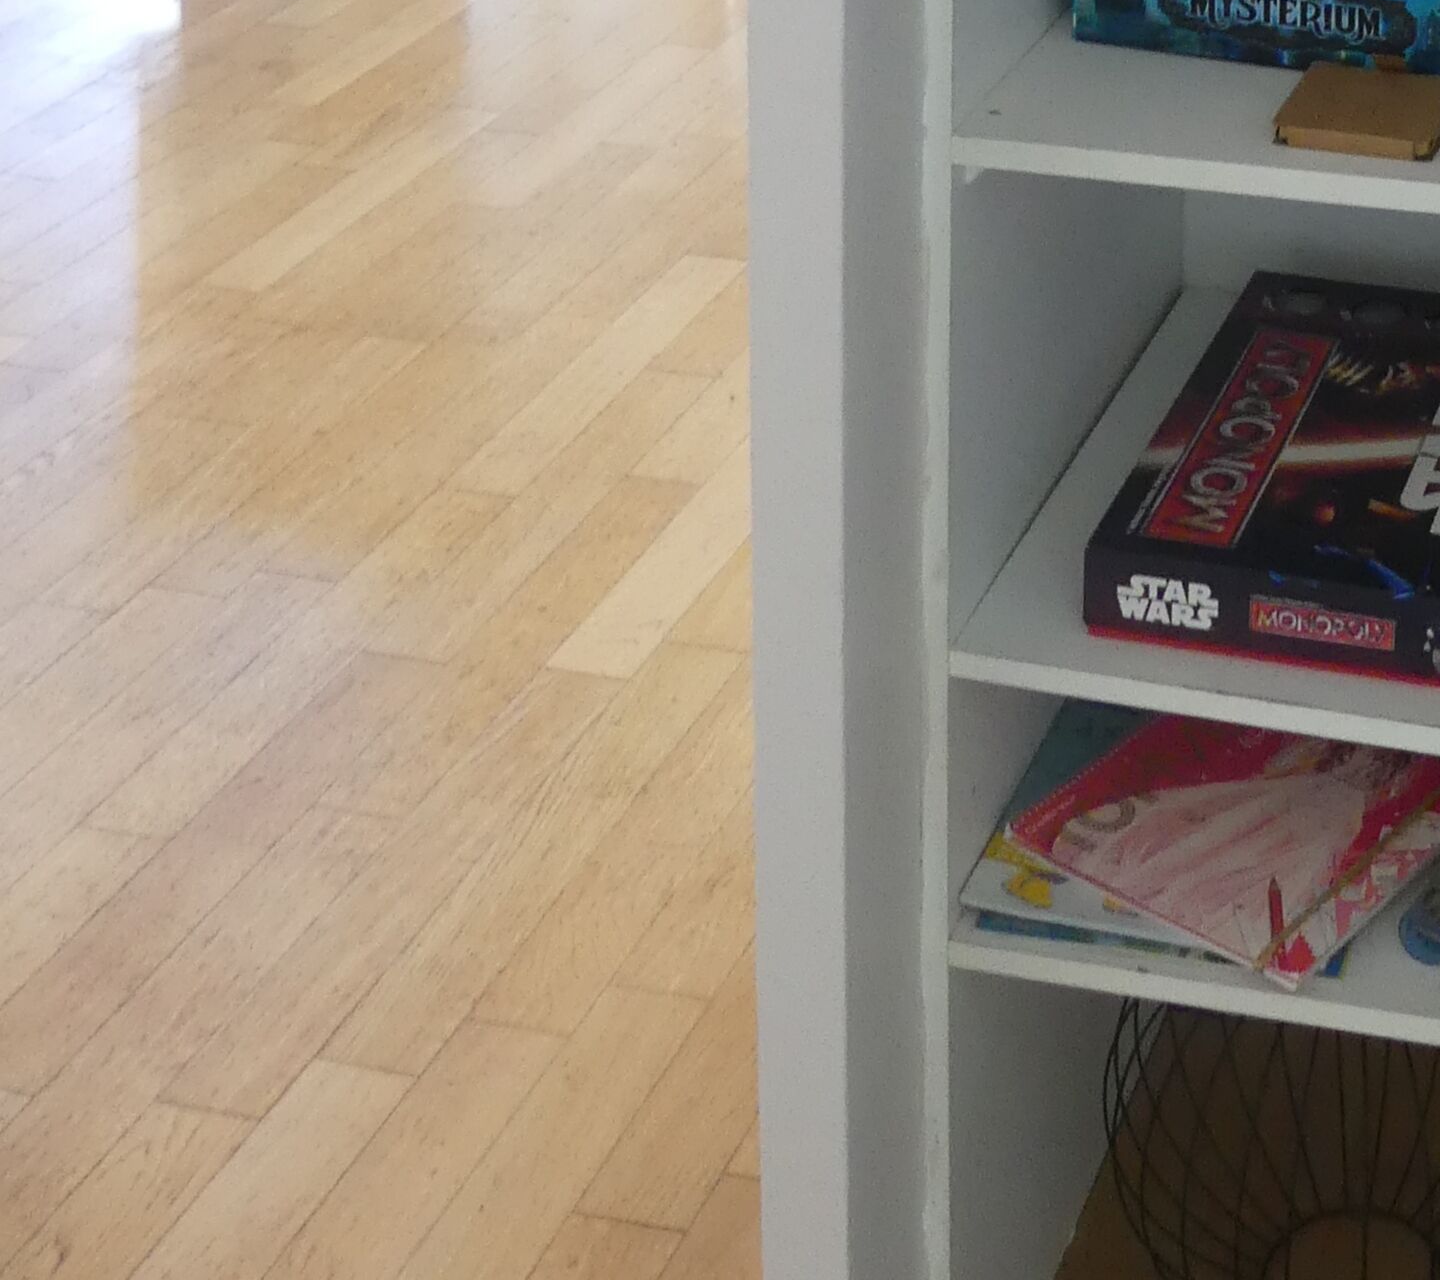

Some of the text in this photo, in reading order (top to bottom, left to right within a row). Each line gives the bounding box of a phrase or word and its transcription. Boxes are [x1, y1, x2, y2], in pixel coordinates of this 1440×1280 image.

[1175, 340, 1311, 533] MONOPOLY
[1117, 574, 1219, 609] STAR
[1117, 594, 1219, 631] WARS
[1257, 611, 1386, 643] MONOPOLY
